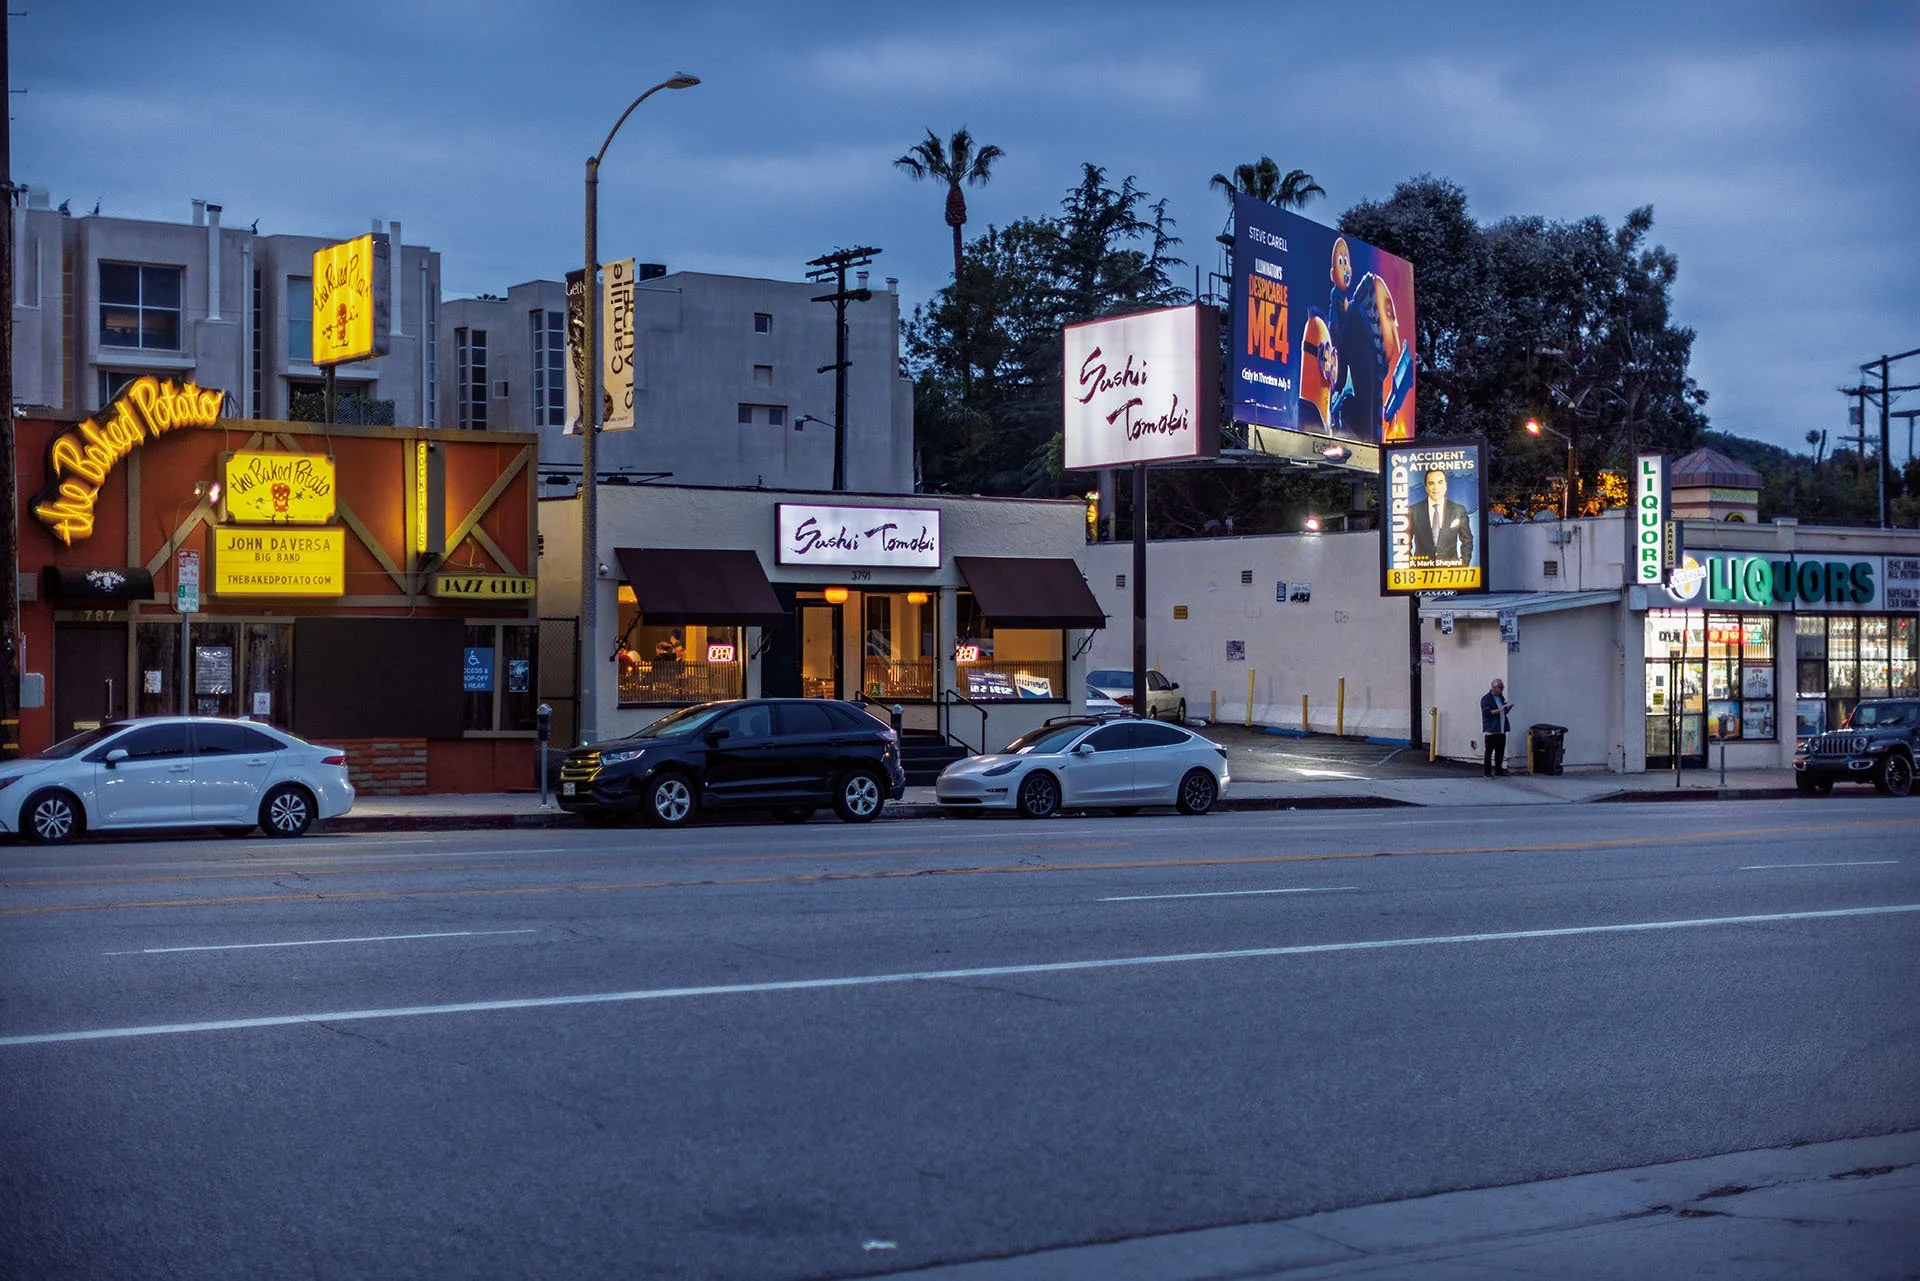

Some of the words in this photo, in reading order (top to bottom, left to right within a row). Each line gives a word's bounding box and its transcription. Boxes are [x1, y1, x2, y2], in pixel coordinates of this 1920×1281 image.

[1249, 226, 1266, 244] STEVE
[1267, 233, 1288, 252] CARELL
[1248, 273, 1288, 306] DESPICABLE
[611, 263, 623, 374] Camille
[1072, 346, 1147, 404] Sushi
[1241, 367, 1253, 384] Only
[129, 376, 225, 437] Potato
[1106, 394, 1188, 441] Tomoki
[52, 400, 144, 486] Baked
[1409, 451, 1465, 462] ACCIDENT
[230, 471, 255, 495] the
[248, 457, 292, 485] Baked
[295, 459, 330, 497] Potato
[1409, 460, 1475, 472] ATTORNEYS
[33, 482, 100, 546] the
[1391, 454, 1410, 570] INJURED?
[1641, 461, 1658, 579] LIQUORS
[228, 537, 263, 551] JOHN
[271, 537, 331, 551] DAVERSA
[788, 517, 859, 554] Sushi
[864, 524, 935, 553] Tomoki
[254, 552, 271, 562] BIG
[277, 553, 300, 562] BAND
[1417, 559, 1434, 567] Mark
[441, 579, 483, 593] JAZZ
[491, 579, 532, 594] CLUB
[851, 571, 871, 581] 3791
[1393, 569, 1476, 584] 818-777-7777
[1708, 557, 1875, 606] LIQUORS
[711, 647, 731, 659] OPEN
